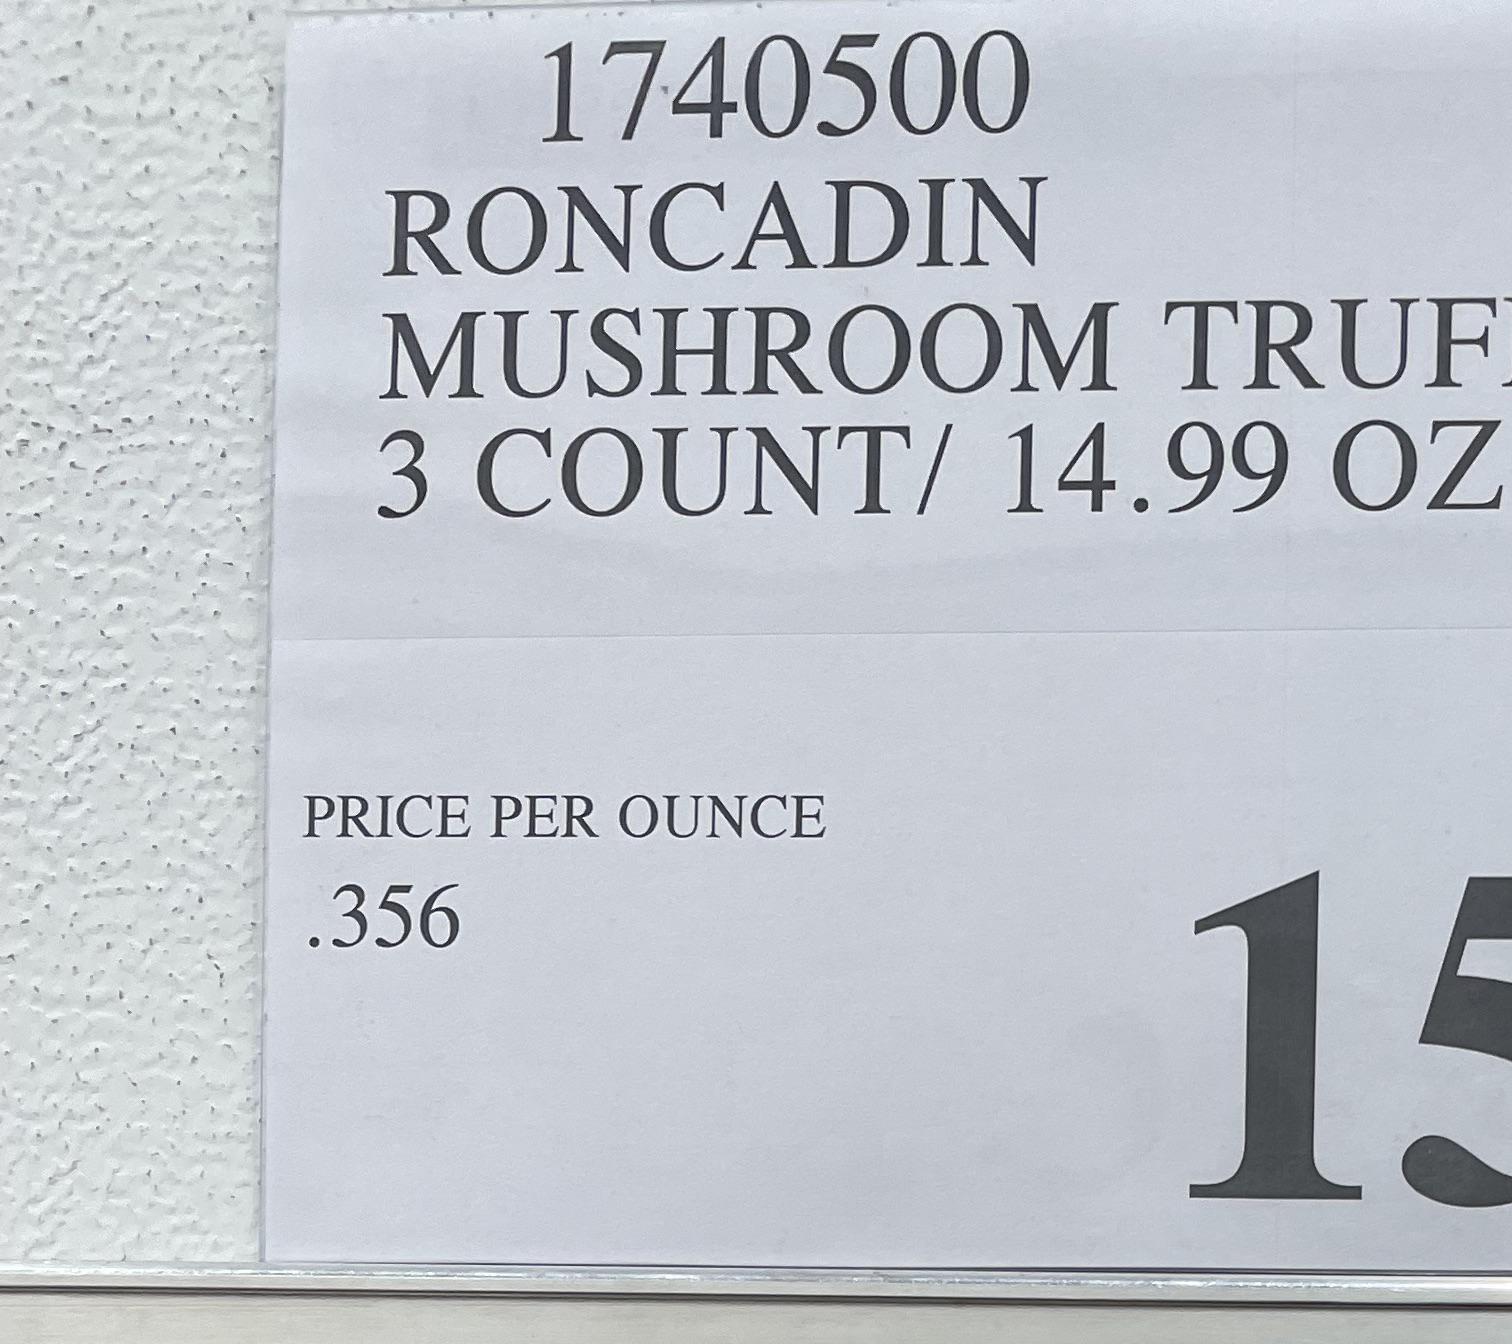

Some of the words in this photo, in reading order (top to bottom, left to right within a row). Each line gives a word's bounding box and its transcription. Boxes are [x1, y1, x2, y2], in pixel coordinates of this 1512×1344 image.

[541, 28, 1031, 143] 1740500
[381, 175, 1050, 278] RONCADIN
[377, 300, 1121, 400] MUSHROOM
[376, 428, 428, 519] 3
[476, 422, 954, 518] COUNT/
[1005, 418, 1289, 514] 14.99
[1331, 418, 1503, 512] OZ
[303, 794, 471, 838] PRICE
[490, 794, 599, 838] PER
[618, 794, 827, 839] OUNCE
[307, 883, 461, 948] .356
